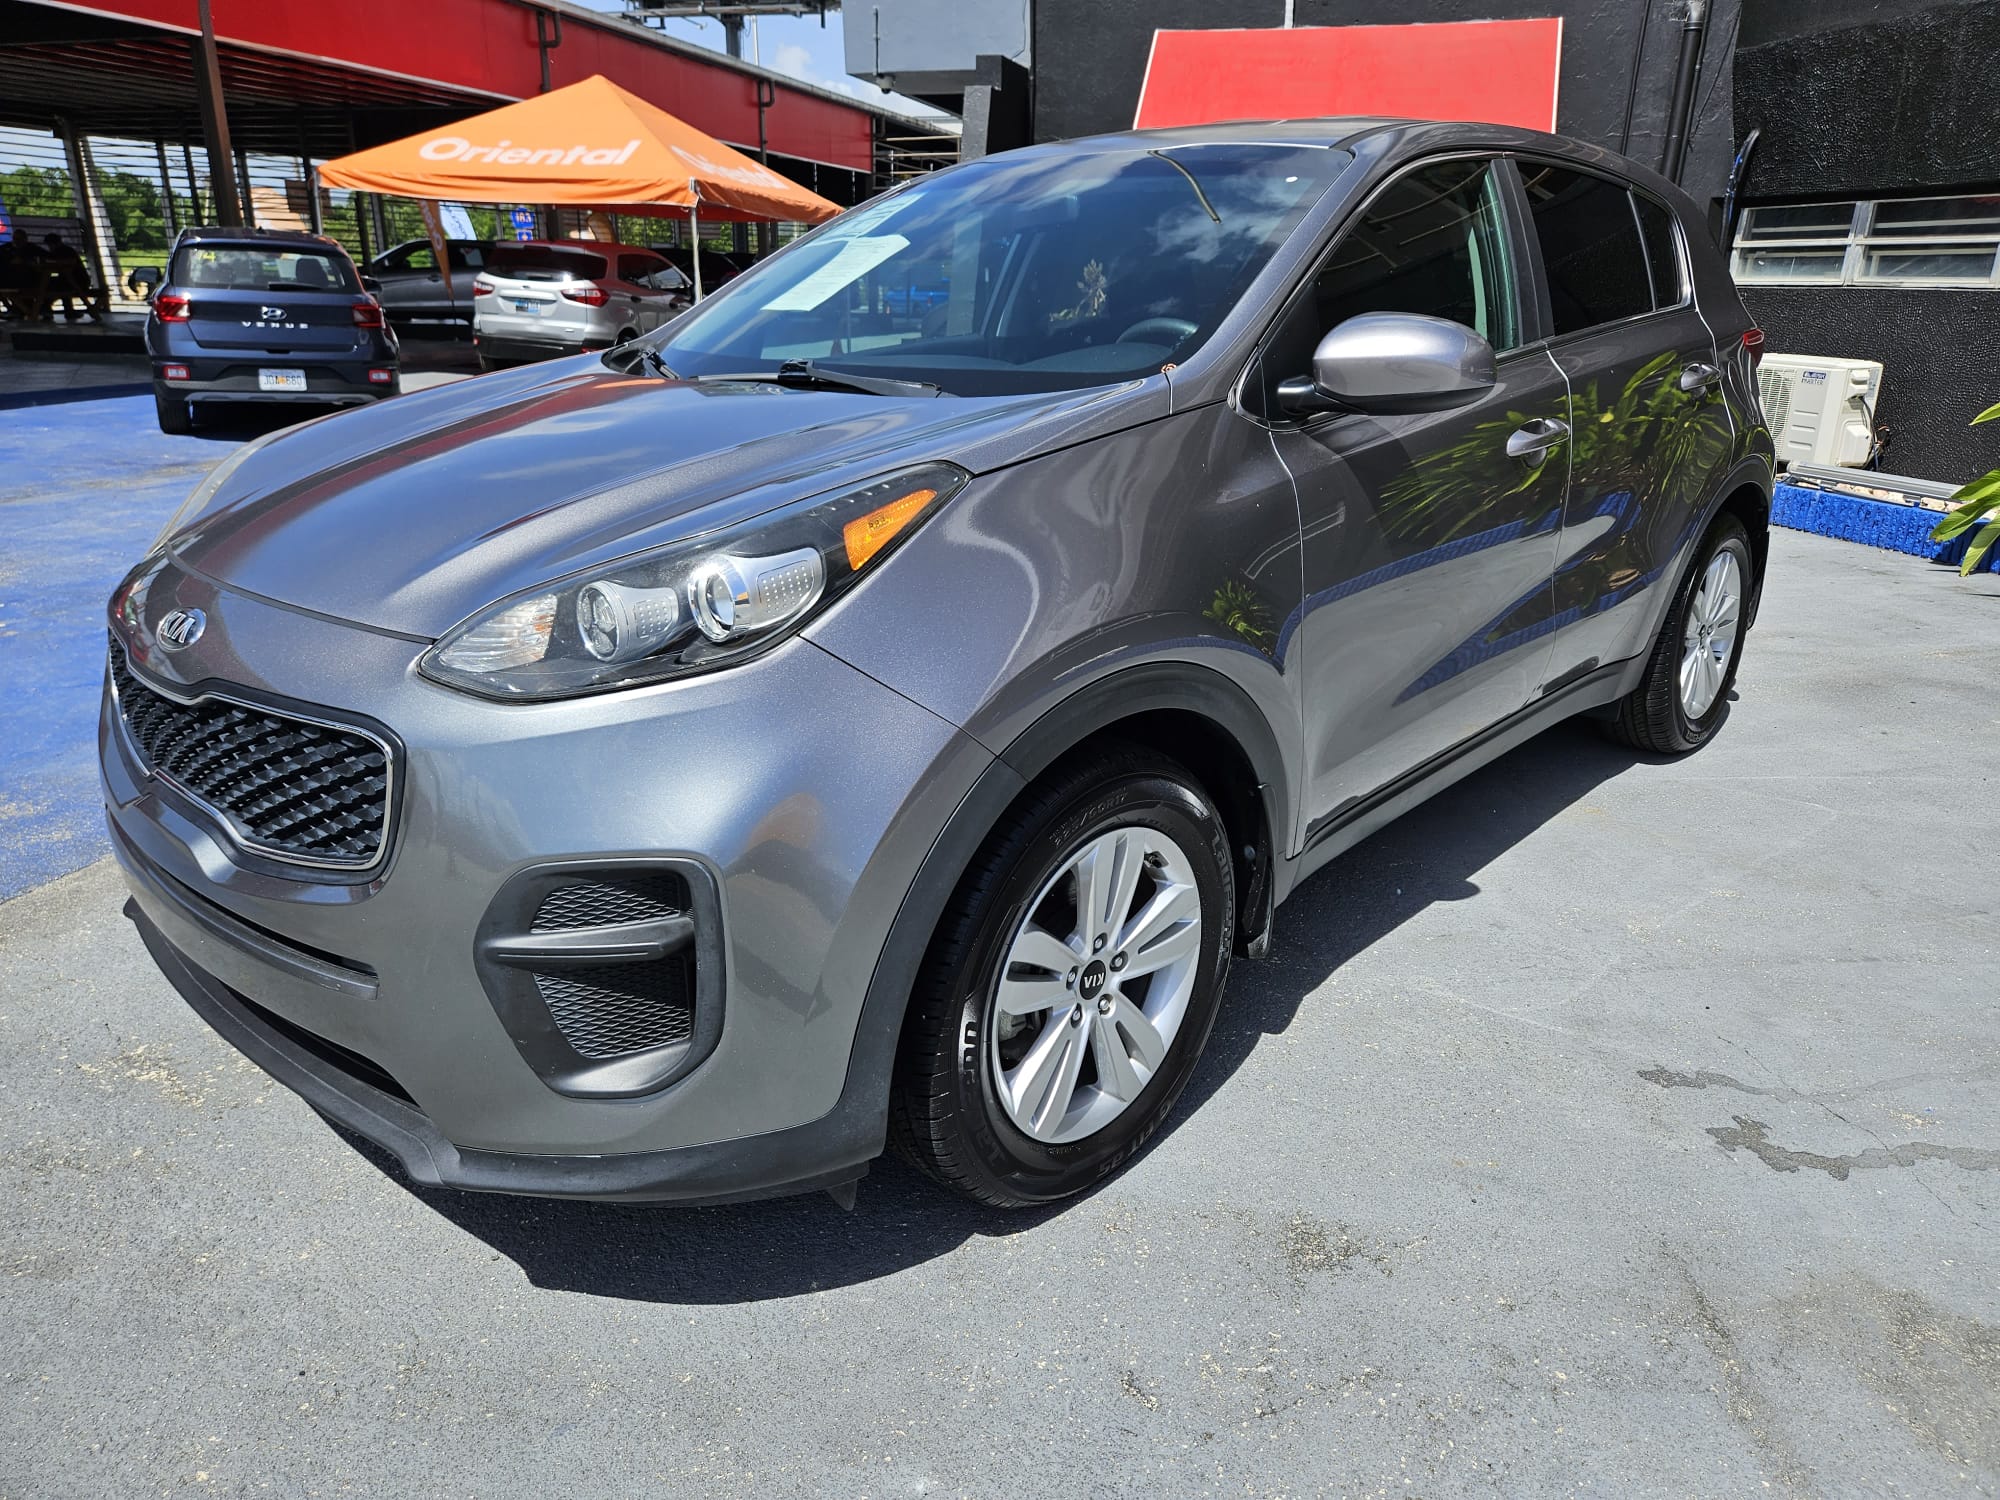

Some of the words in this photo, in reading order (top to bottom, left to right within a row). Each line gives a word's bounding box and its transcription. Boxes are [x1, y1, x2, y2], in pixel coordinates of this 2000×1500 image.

[420, 137, 642, 166] Oriental
[241, 321, 309, 329] VENUE
[160, 611, 196, 644] KIA
[1084, 972, 1105, 989] KIA
